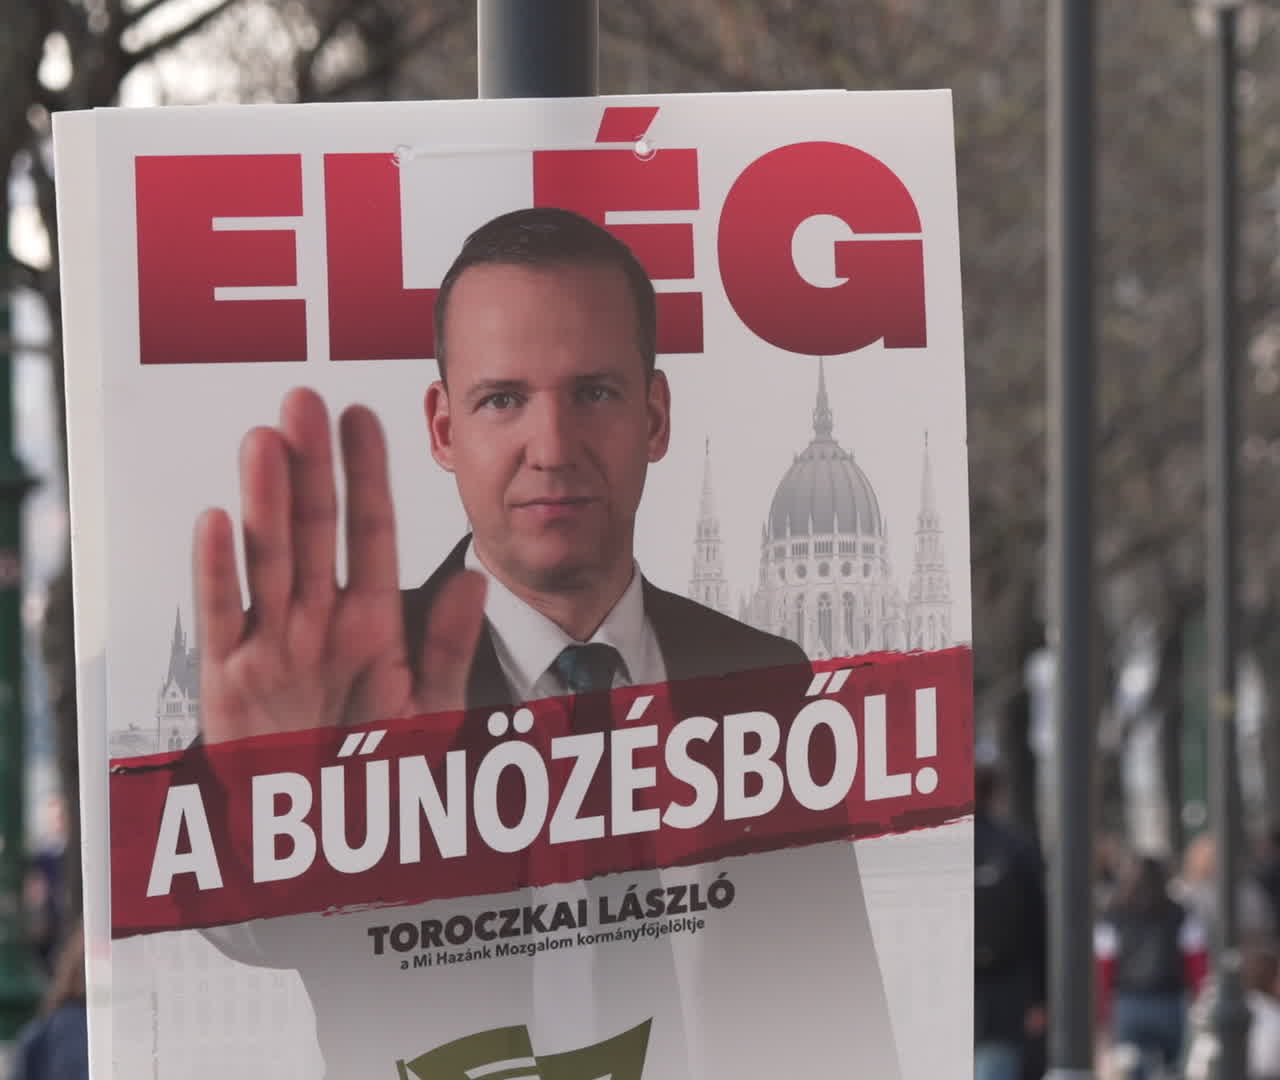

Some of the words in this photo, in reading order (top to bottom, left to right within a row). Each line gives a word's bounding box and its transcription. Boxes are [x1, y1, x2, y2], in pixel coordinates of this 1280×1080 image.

[134, 106, 927, 364] ELÉG
[146, 783, 223, 898] A
[252, 669, 939, 884] BŰNÖZÉSBŐL!
[368, 899, 588, 955] TOROCZKAI
[599, 872, 736, 924] LÁSZLÓ
[413, 953, 433, 968] Mi
[436, 946, 491, 965] Hazánk
[496, 937, 574, 959] Mozgalom
[576, 918, 706, 948] kormányfőjelöltje
